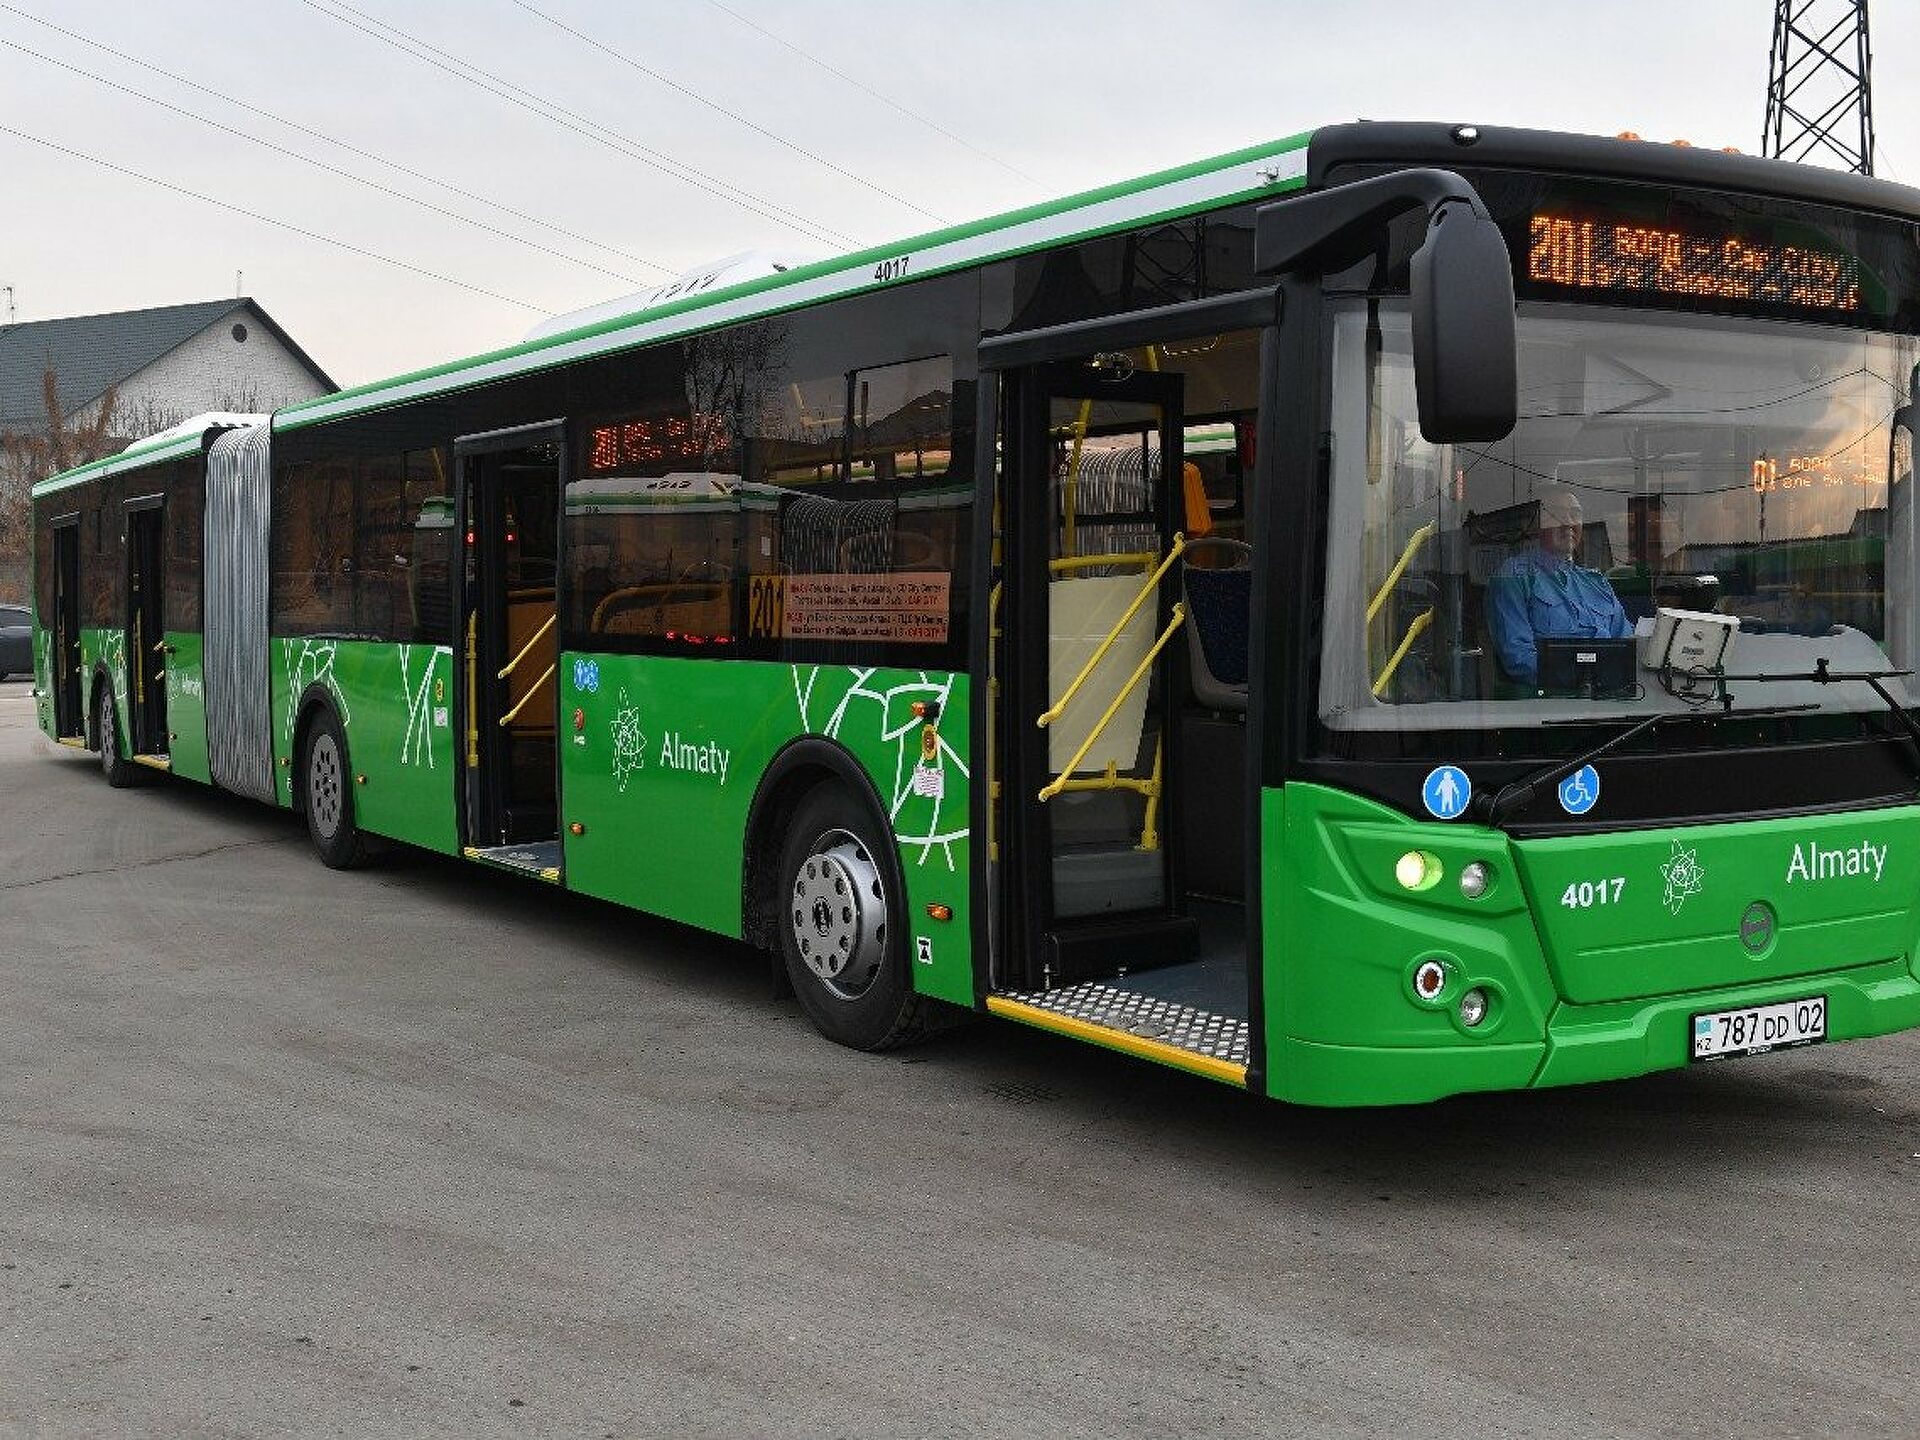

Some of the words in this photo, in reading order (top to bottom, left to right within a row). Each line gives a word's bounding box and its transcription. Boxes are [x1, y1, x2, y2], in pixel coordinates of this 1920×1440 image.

[874, 256, 909, 282] 4017
[1529, 215, 1593, 287] 201
[1723, 239, 1768, 272] Car
[1784, 247, 1840, 281] City
[752, 578, 784, 639] 201
[660, 731, 730, 786] Almaty
[1786, 840, 1888, 883] Almaty
[1561, 877, 1626, 909] 4017
[1696, 1038, 1712, 1050] KZ
[1719, 1013, 1759, 1047] 787
[1764, 1016, 1789, 1040] DD
[1798, 1003, 1823, 1034] 02
